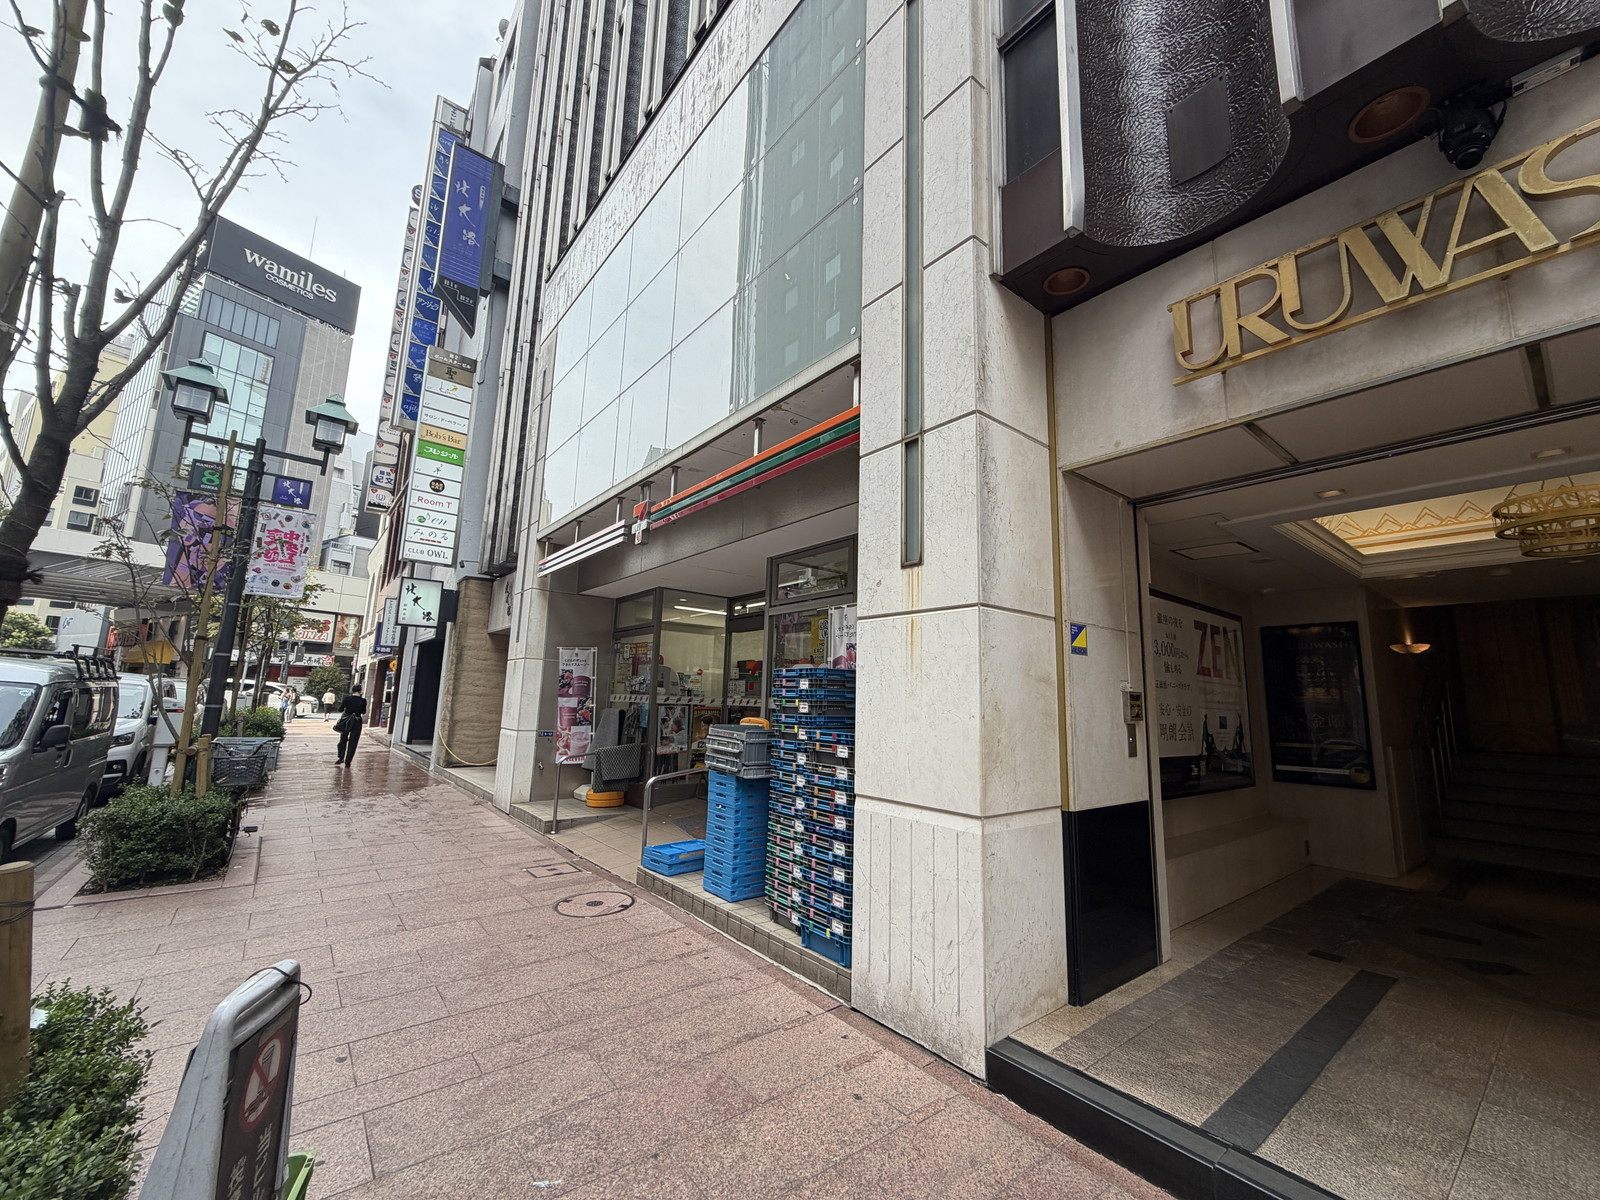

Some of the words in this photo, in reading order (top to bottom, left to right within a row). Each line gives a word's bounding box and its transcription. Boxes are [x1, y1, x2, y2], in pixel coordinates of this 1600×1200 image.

[243, 247, 337, 303] wamiles
[265, 273, 314, 300] COSMETICS
[425, 428, 447, 441] Bob's
[447, 434, 462, 445] Bar
[201, 470, 220, 486] 8
[417, 495, 444, 508] Room
[445, 501, 453, 509] T
[407, 547, 425, 556] CLUB
[426, 549, 449, 560] OWL
[1193, 619, 1242, 683] ZEN
